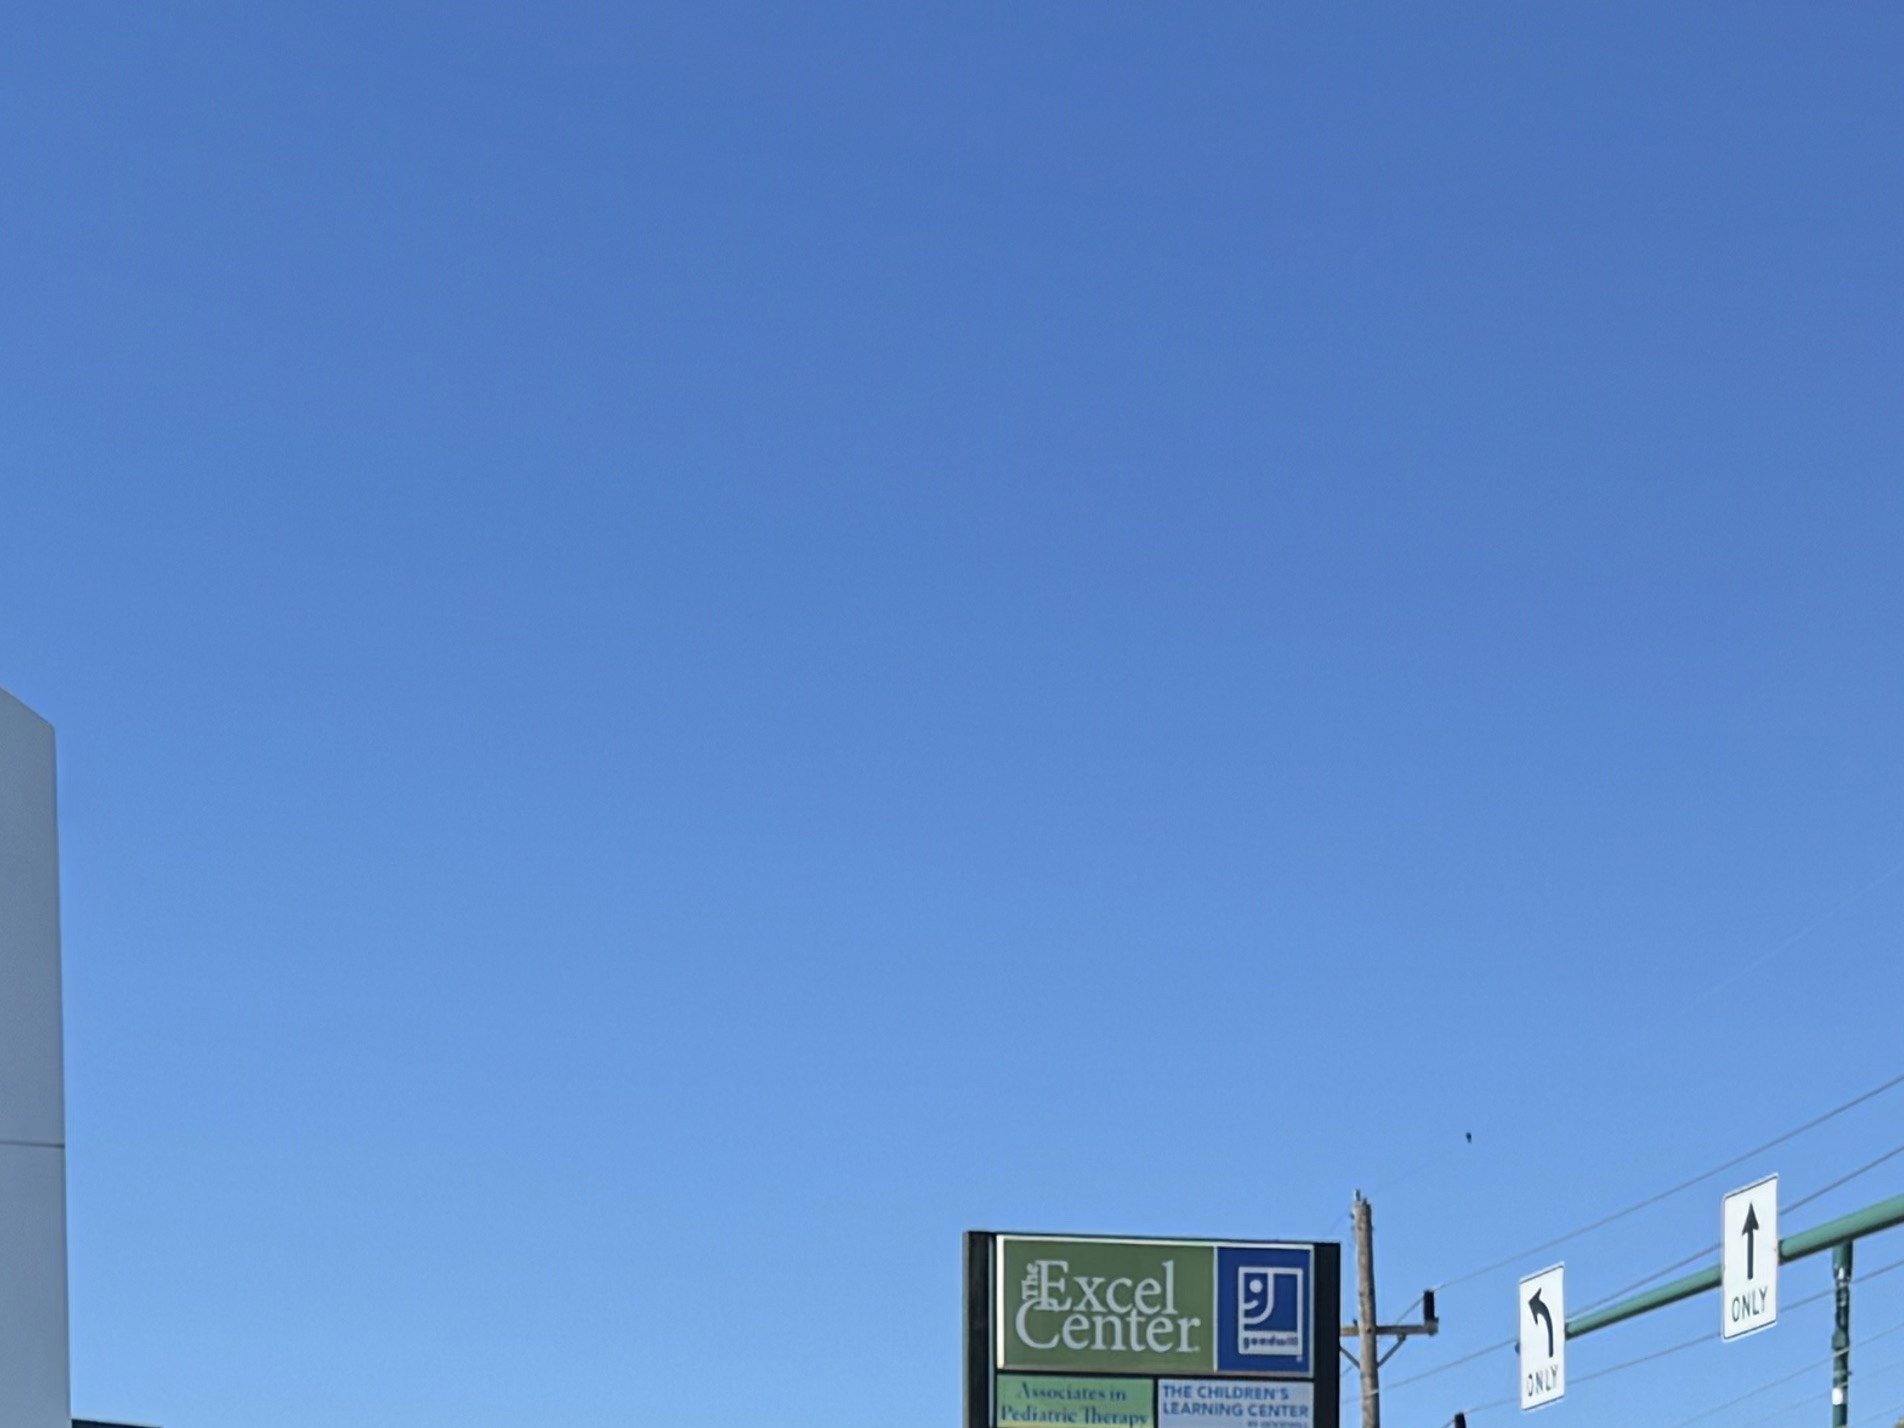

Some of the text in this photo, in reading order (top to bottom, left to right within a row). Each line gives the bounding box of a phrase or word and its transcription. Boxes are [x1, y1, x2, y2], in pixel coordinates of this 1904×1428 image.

[1021, 1263, 1038, 1300] The
[1034, 1260, 1178, 1314] Excel
[1731, 1286, 1768, 1322] ONLY
[1015, 1298, 1201, 1352] Center
[1017, 1381, 1127, 1402] Associates in
[1162, 1385, 1289, 1400] THE CHILDREN'S
[1526, 1365, 1559, 1397] ONLY
[1000, 1404, 1077, 1424] Pediatric
[1162, 1402, 1309, 1418] LEARNING CENTER
